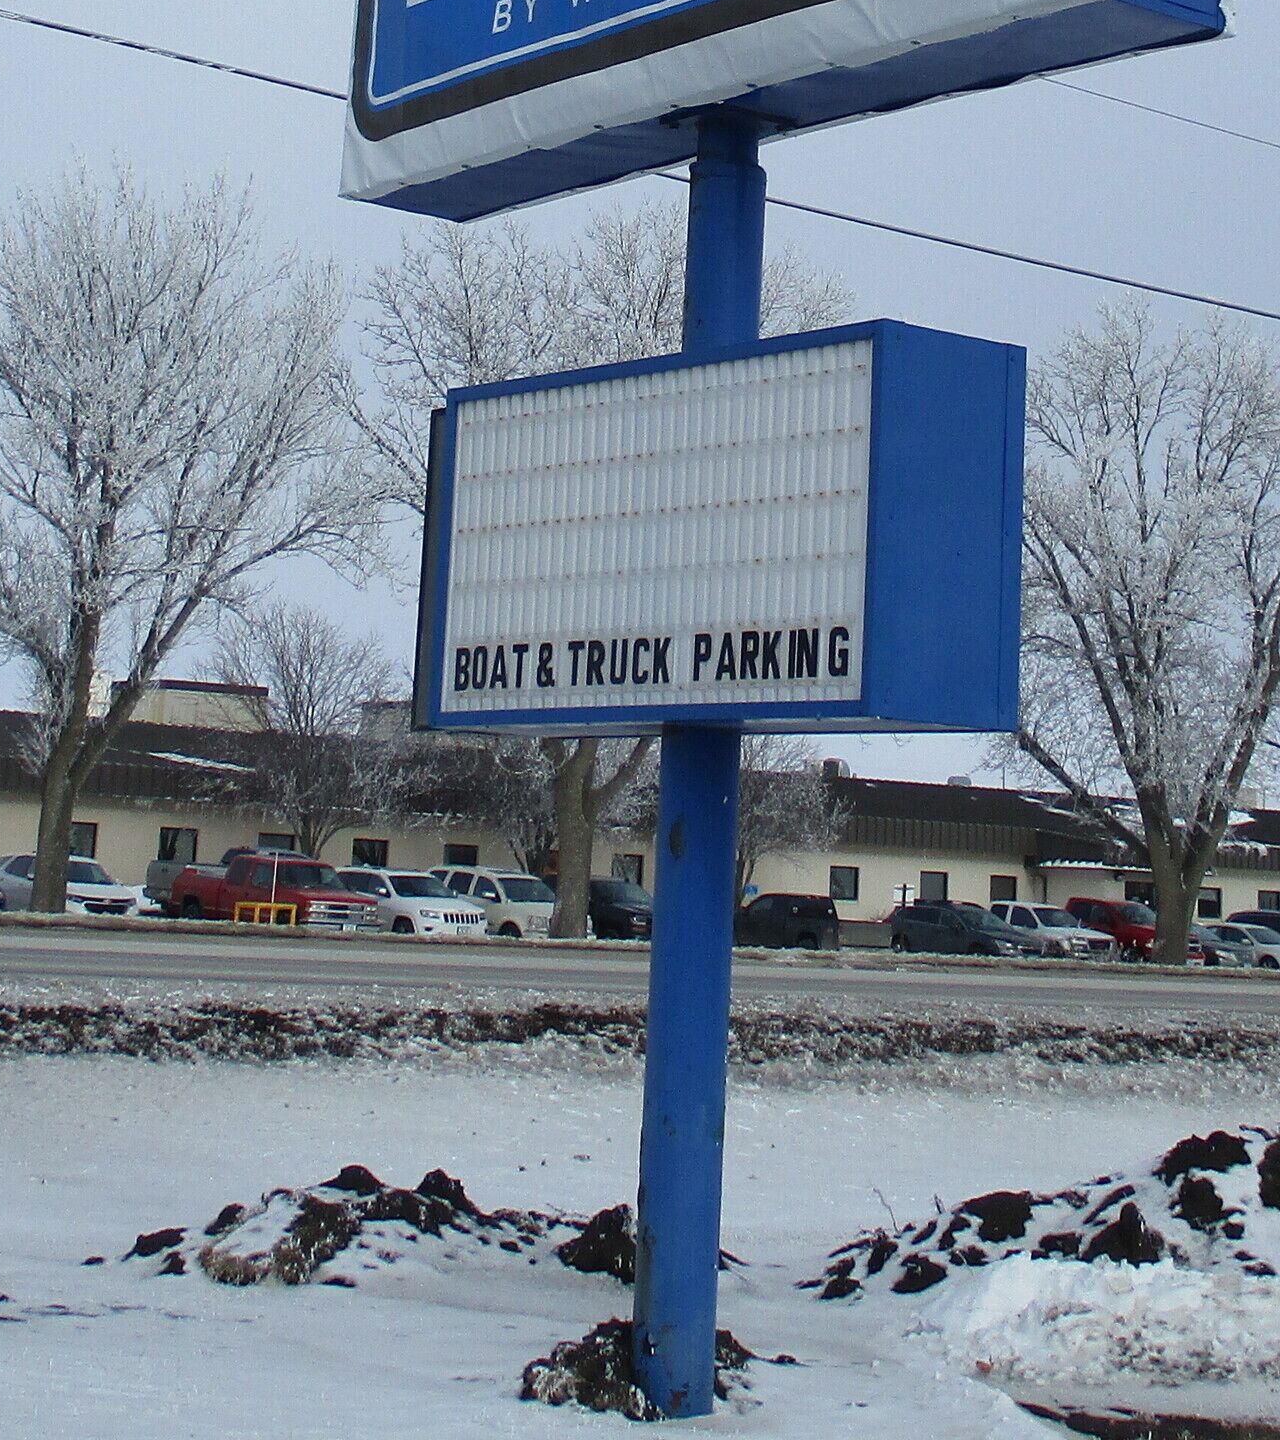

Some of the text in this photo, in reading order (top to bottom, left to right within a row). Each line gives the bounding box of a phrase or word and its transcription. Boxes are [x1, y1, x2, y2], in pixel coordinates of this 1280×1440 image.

[454, 626, 850, 692] BOAT & TRUCK PARKING
